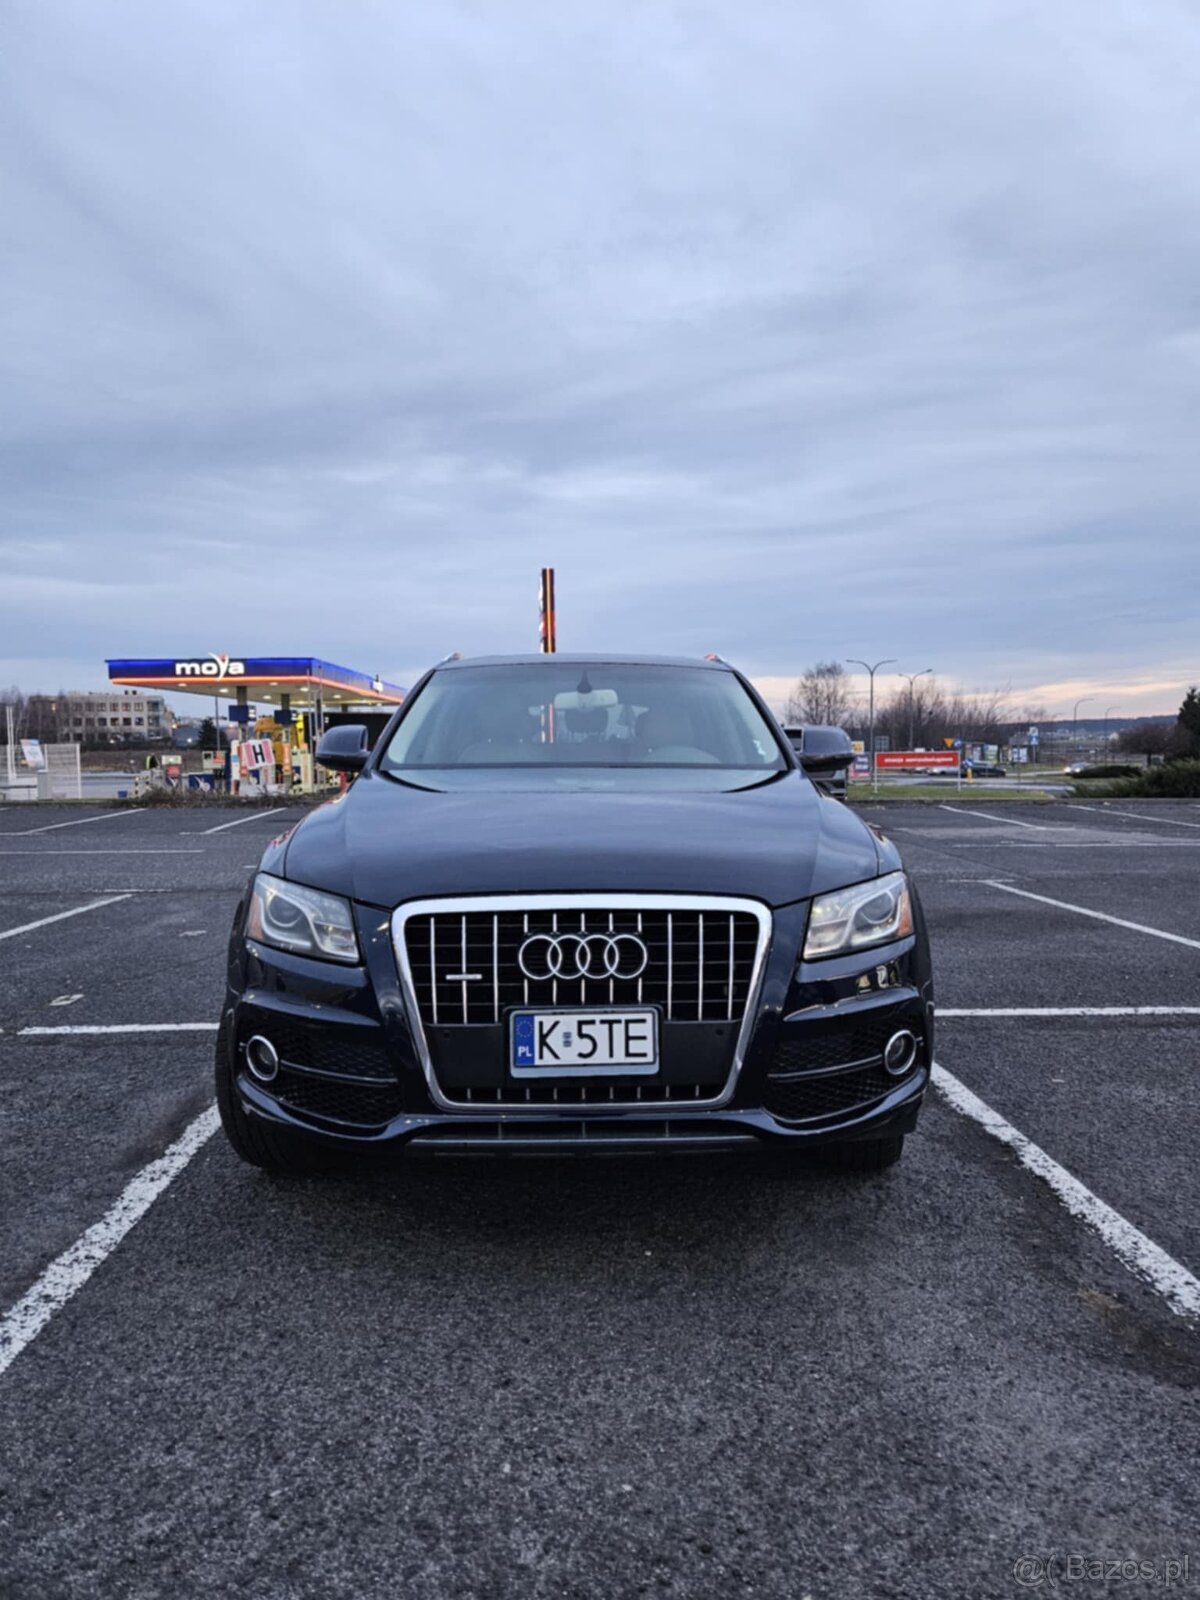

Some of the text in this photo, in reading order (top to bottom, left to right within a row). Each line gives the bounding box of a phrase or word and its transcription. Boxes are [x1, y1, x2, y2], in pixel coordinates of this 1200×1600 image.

[175, 652, 245, 681] moya
[252, 743, 266, 764] H
[517, 1045, 532, 1057] PL
[538, 1018, 648, 1060] K 5TE
